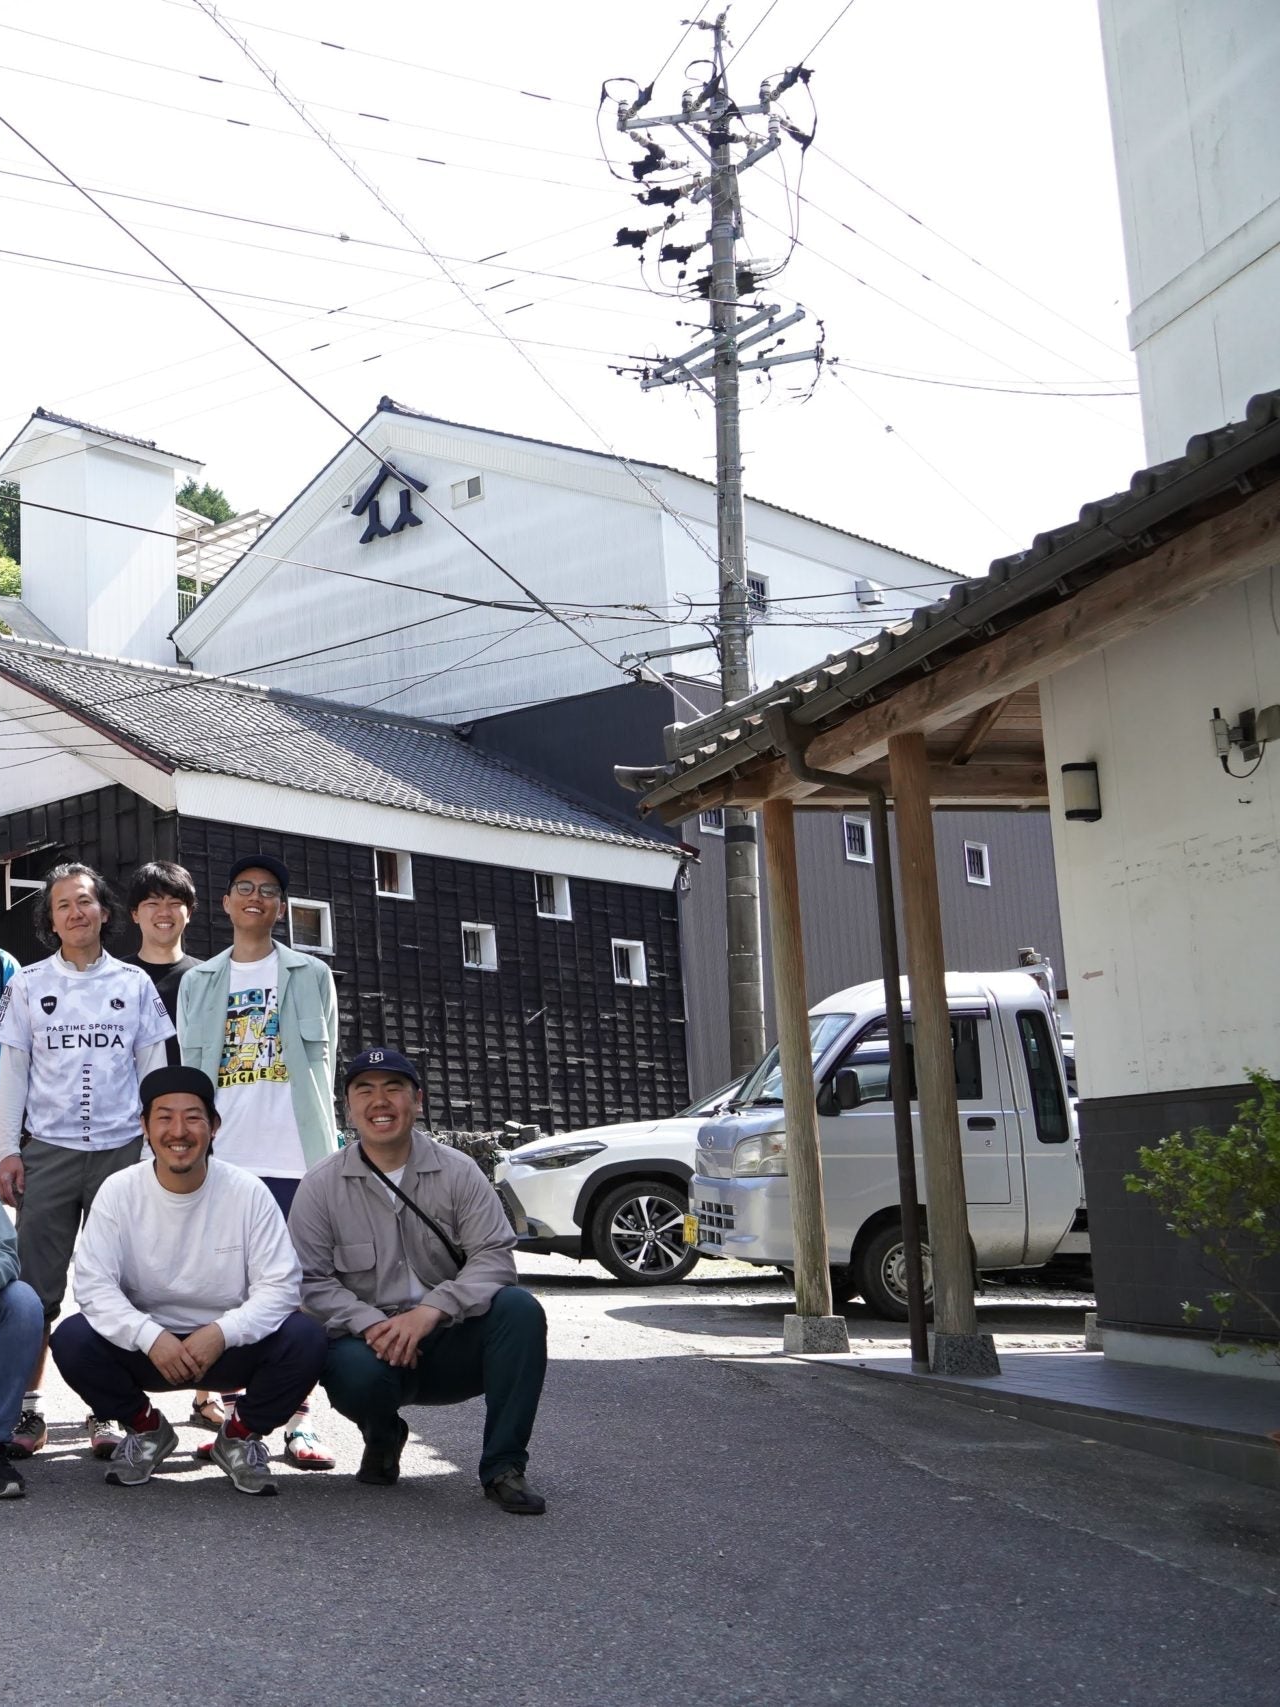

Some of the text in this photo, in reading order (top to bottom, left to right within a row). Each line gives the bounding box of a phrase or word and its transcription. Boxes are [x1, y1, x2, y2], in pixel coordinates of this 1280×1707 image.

[46, 1023, 125, 1032] PASTIME SPORTS
[47, 1033, 125, 1049] LENDA
